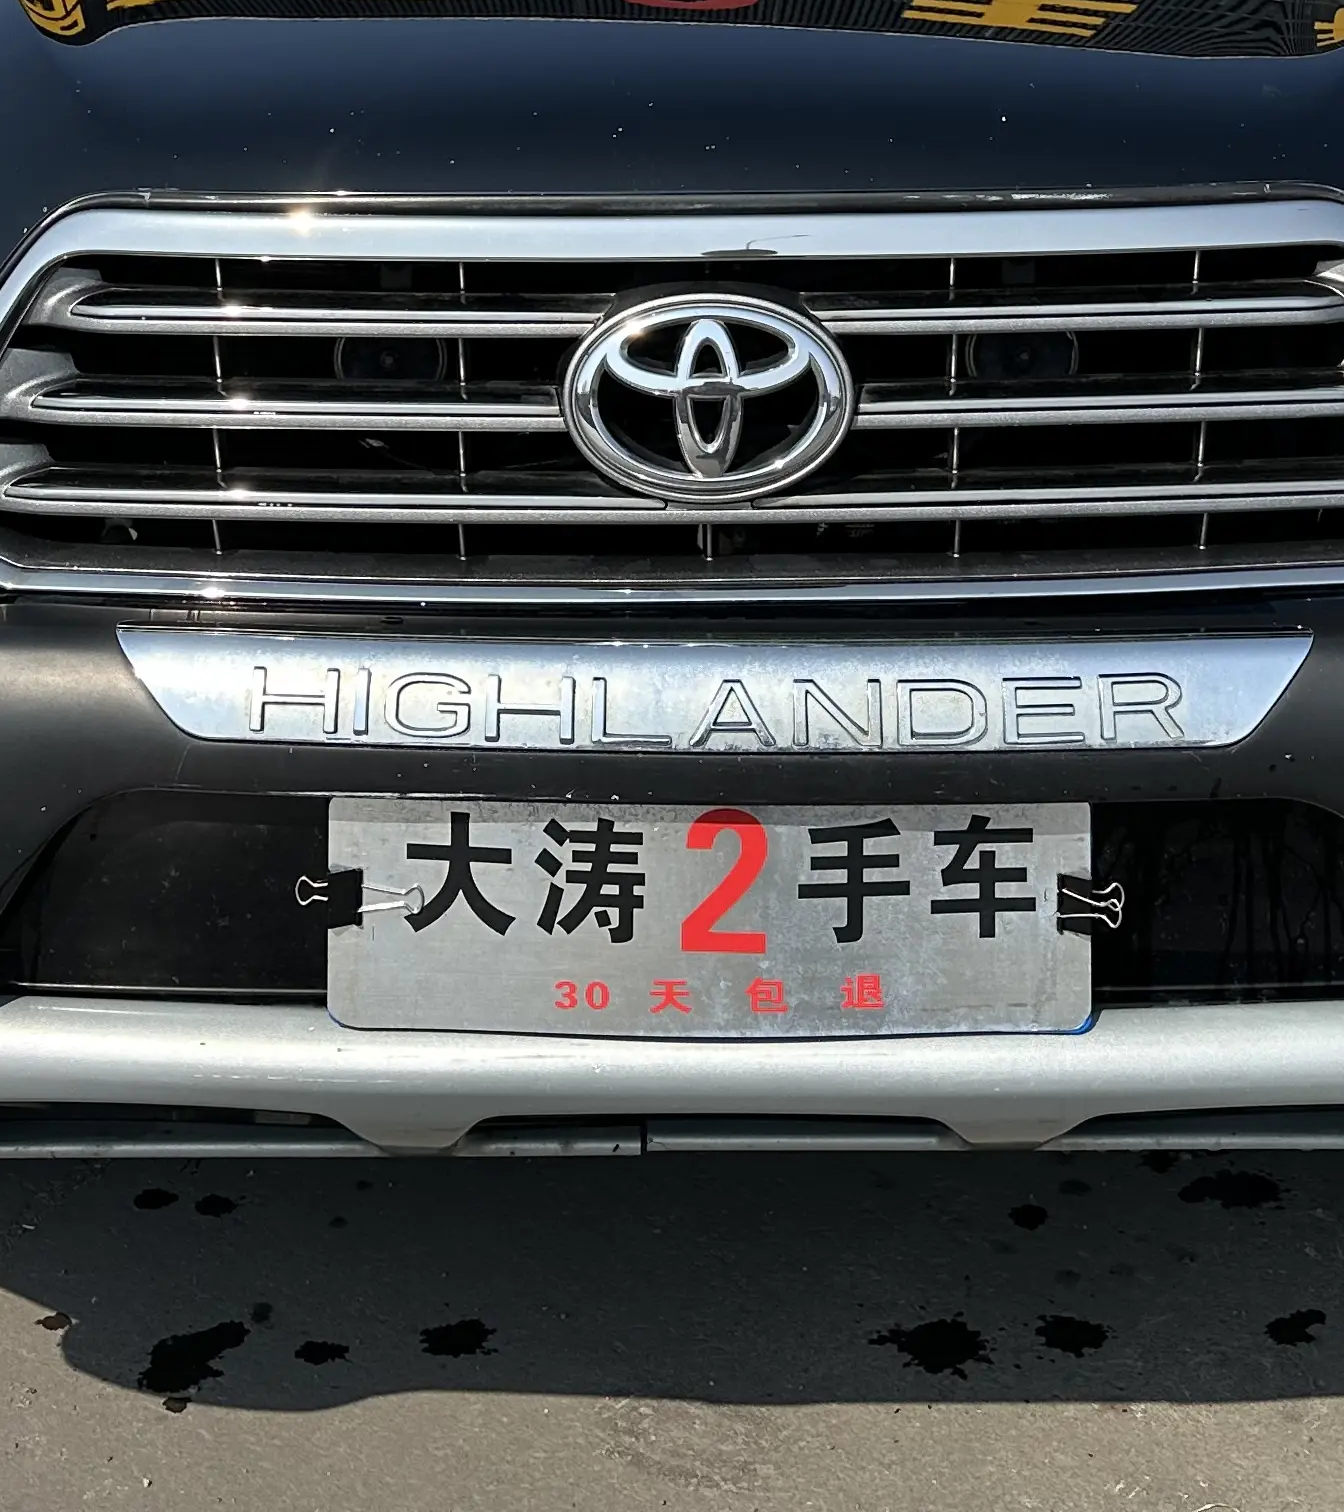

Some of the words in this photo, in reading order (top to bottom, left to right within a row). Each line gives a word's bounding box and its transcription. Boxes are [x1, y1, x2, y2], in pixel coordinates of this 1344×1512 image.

[248, 665, 1186, 751] HIGHLANDER
[403, 806, 1038, 956] 大涛2手车
[553, 972, 886, 1015] 30天包退
